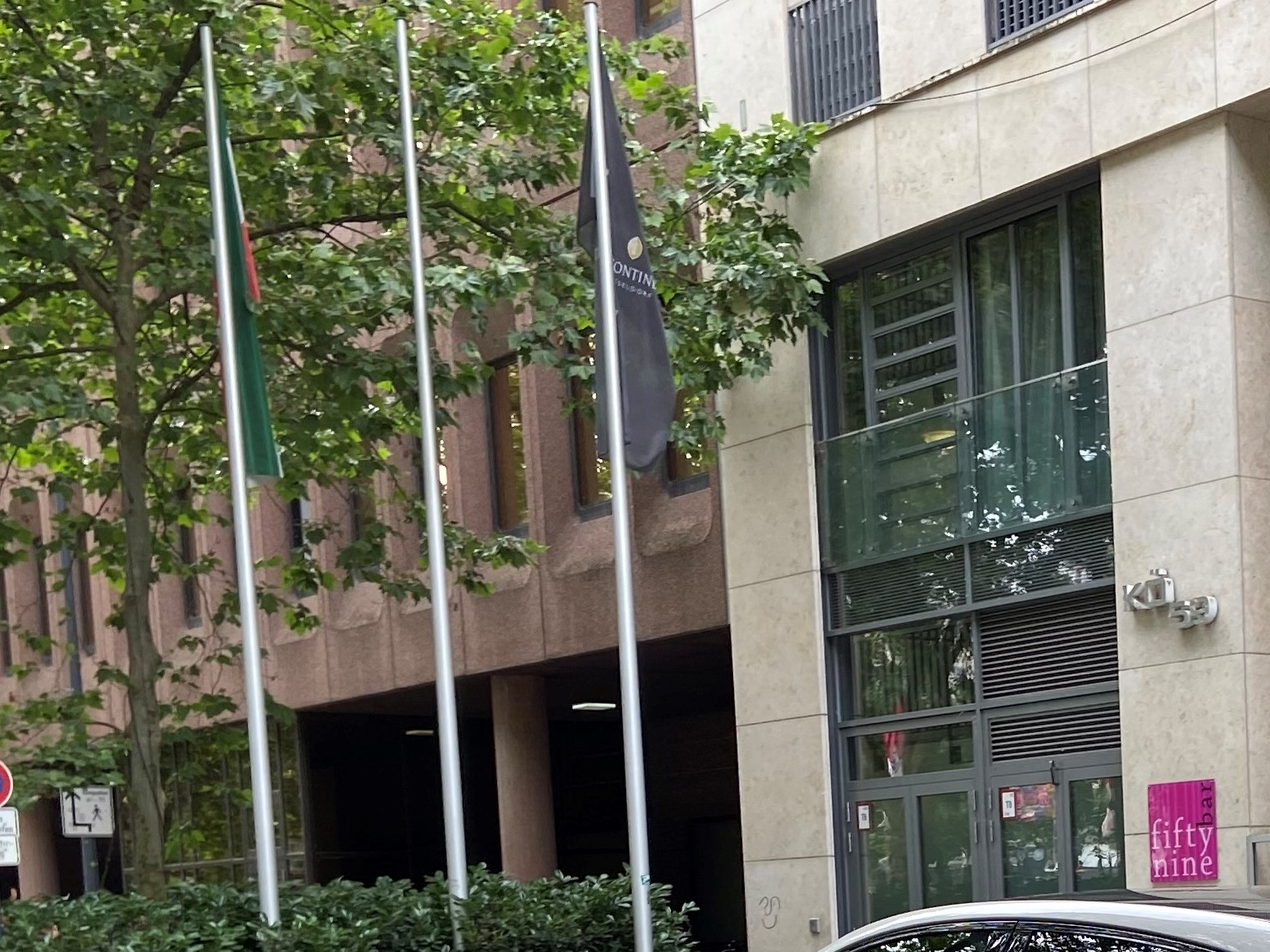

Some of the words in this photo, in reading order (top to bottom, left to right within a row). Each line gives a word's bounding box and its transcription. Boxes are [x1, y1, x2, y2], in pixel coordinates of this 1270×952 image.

[1195, 783, 1213, 826] bar
[1151, 816, 1214, 856] fifty
[1152, 850, 1214, 878] nine
